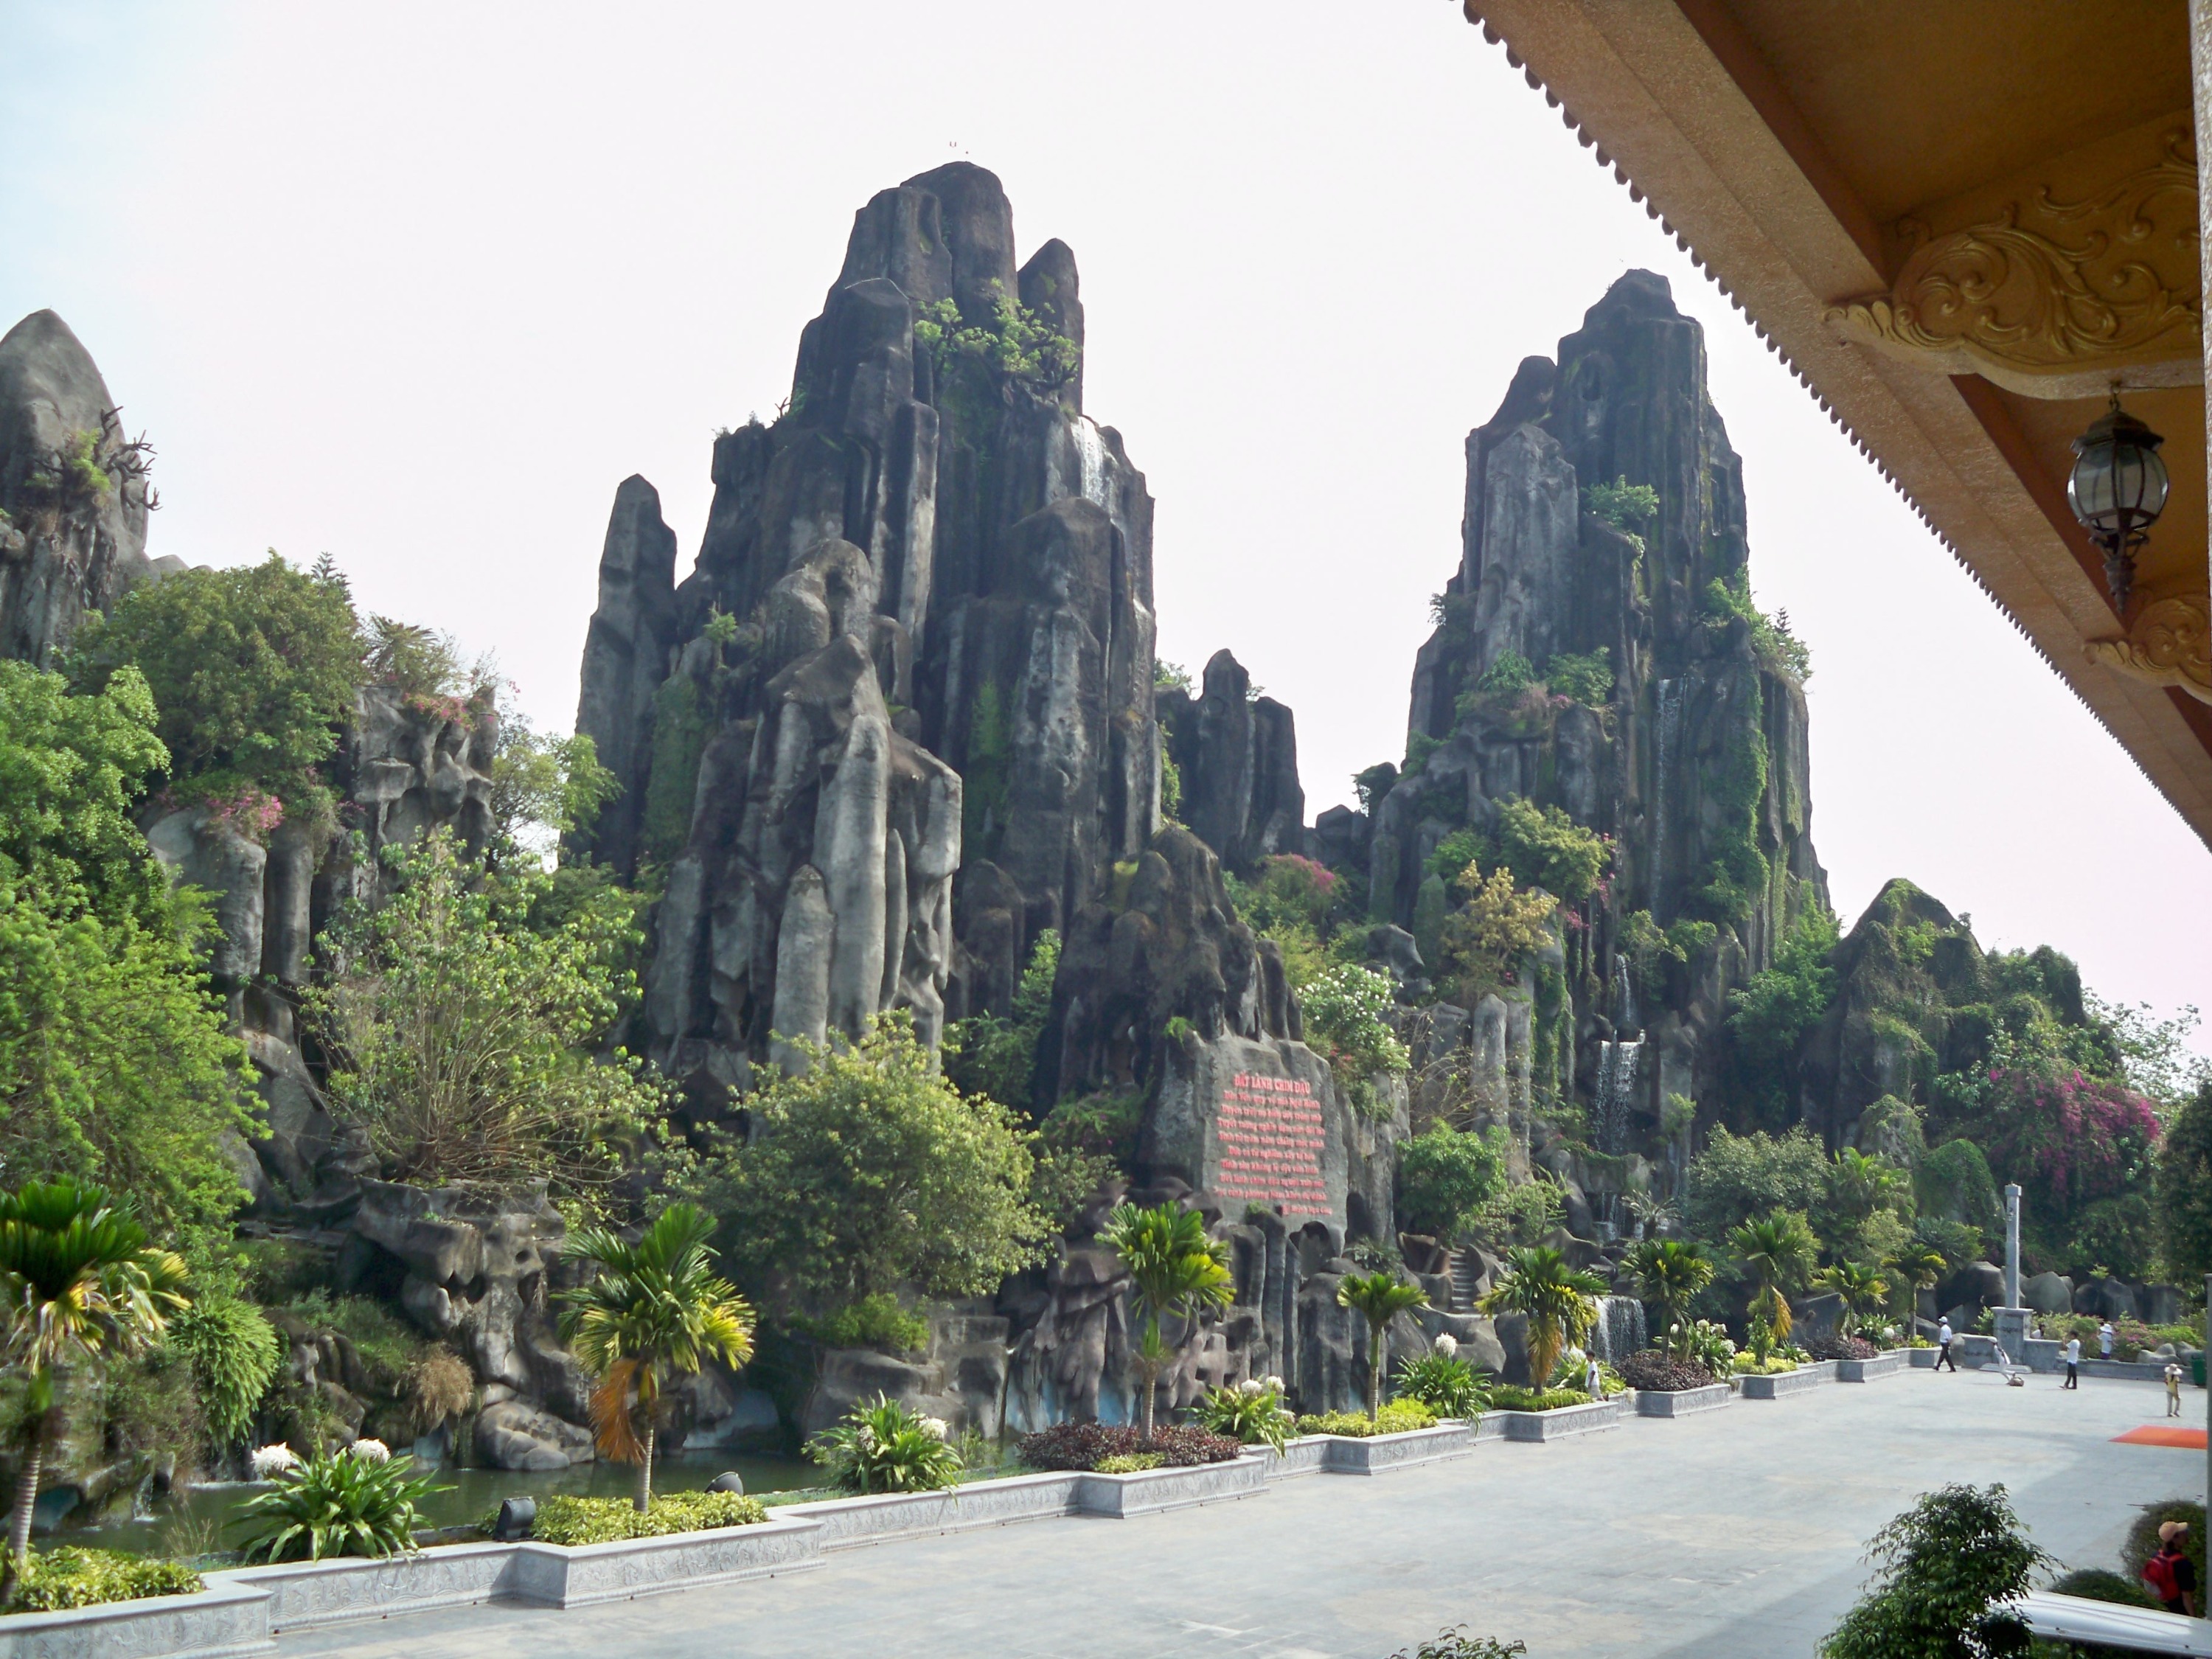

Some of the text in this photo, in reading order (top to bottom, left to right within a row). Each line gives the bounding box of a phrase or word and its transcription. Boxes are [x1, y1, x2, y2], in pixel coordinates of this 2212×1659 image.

[1234, 1070, 1310, 1094] ĐẤT LÀNH CHIM ĐẬU
